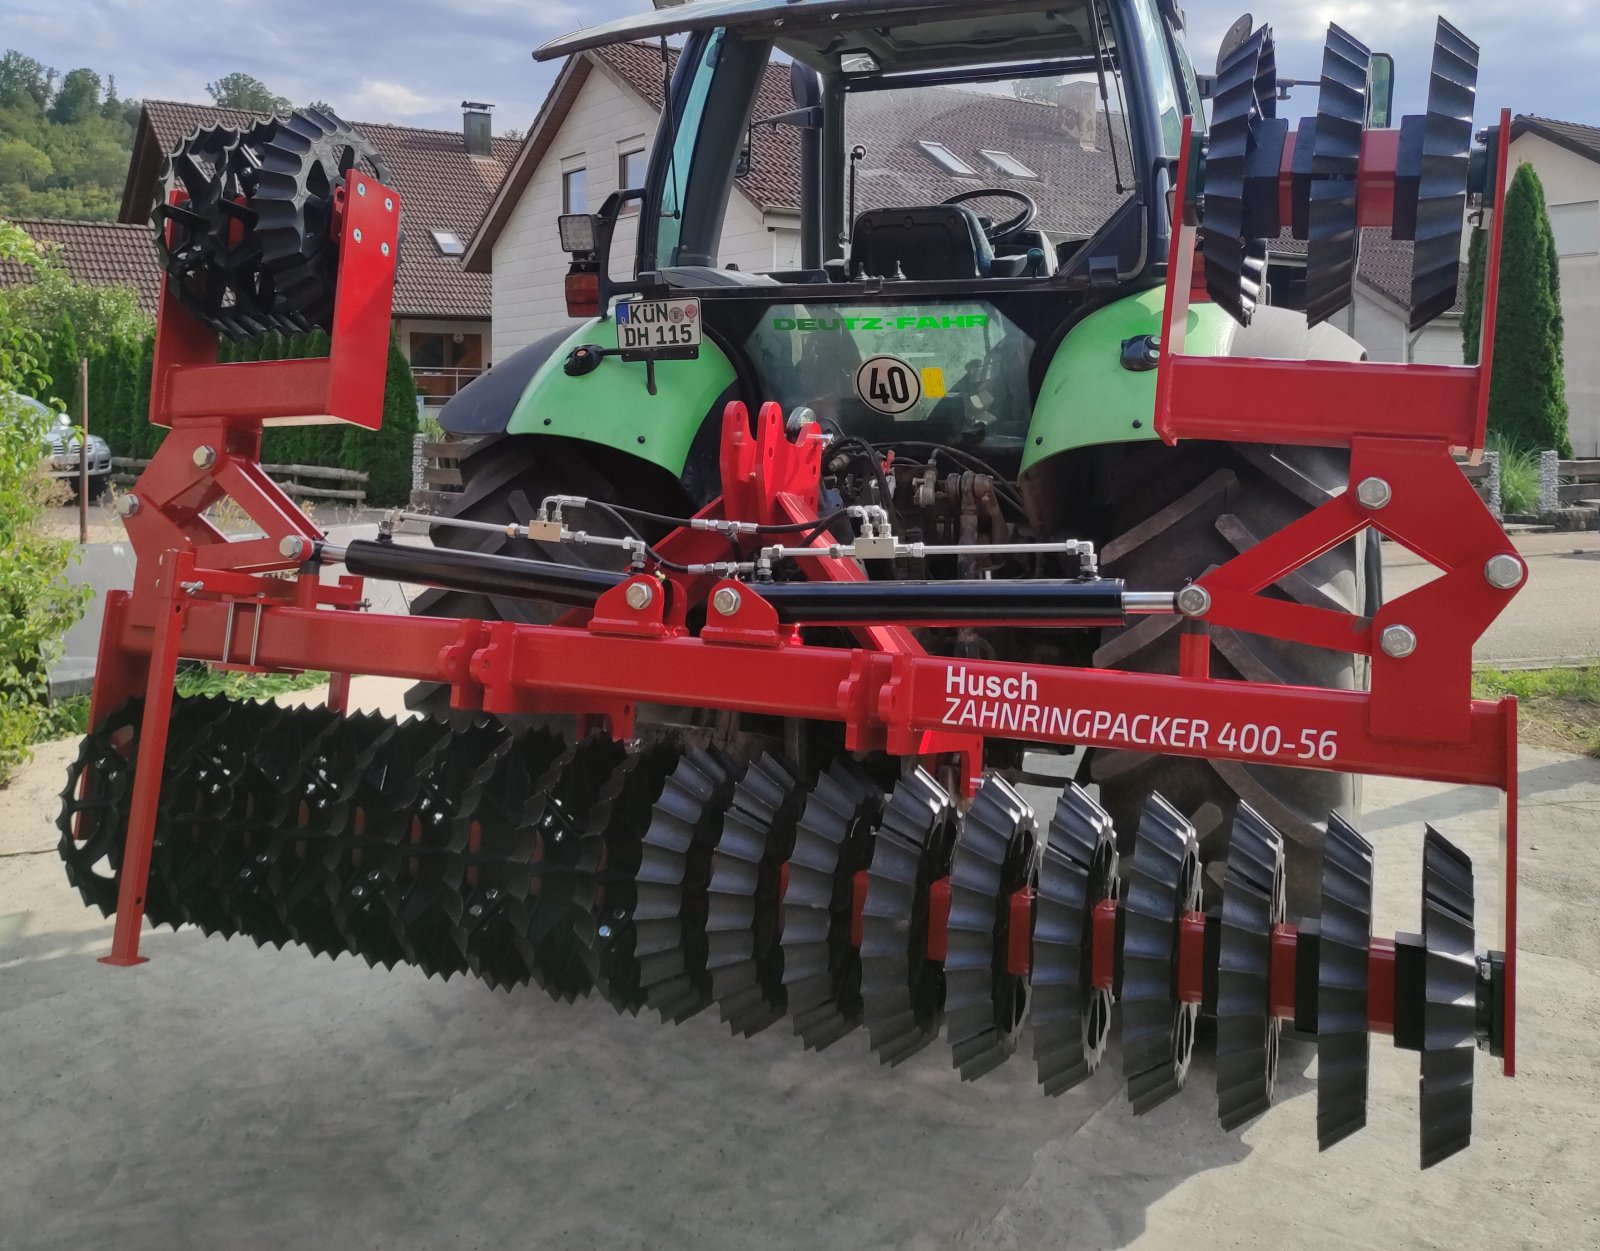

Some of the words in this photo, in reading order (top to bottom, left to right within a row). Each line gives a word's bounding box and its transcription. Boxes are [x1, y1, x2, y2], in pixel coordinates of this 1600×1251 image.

[630, 303, 668, 324] KÜN
[774, 314, 988, 331] DEUTZ-FAHR
[625, 327, 649, 347] DH
[656, 324, 692, 345] 115
[869, 366, 911, 404] 40
[945, 665, 1038, 701] Husch
[941, 697, 1210, 750] ZAHNRINGPACKER
[1217, 722, 1338, 761] 400-56
